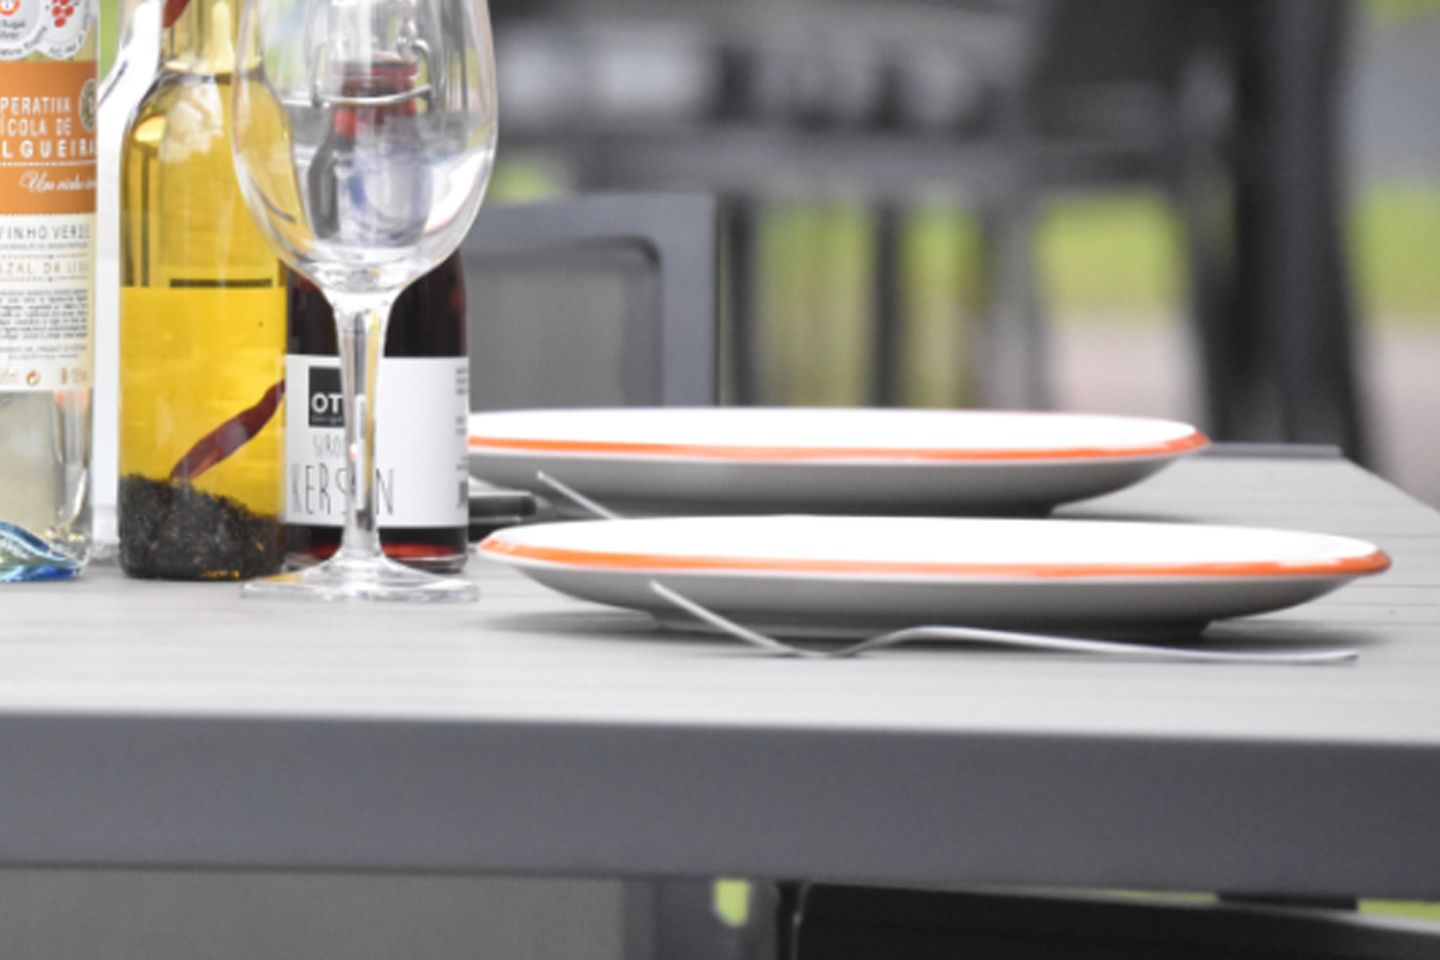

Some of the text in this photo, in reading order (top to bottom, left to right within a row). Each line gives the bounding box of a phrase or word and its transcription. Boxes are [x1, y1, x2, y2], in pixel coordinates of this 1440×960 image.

[56, 118, 72, 136] DE
[311, 393, 345, 414] OT
[291, 462, 394, 516] KERSN
